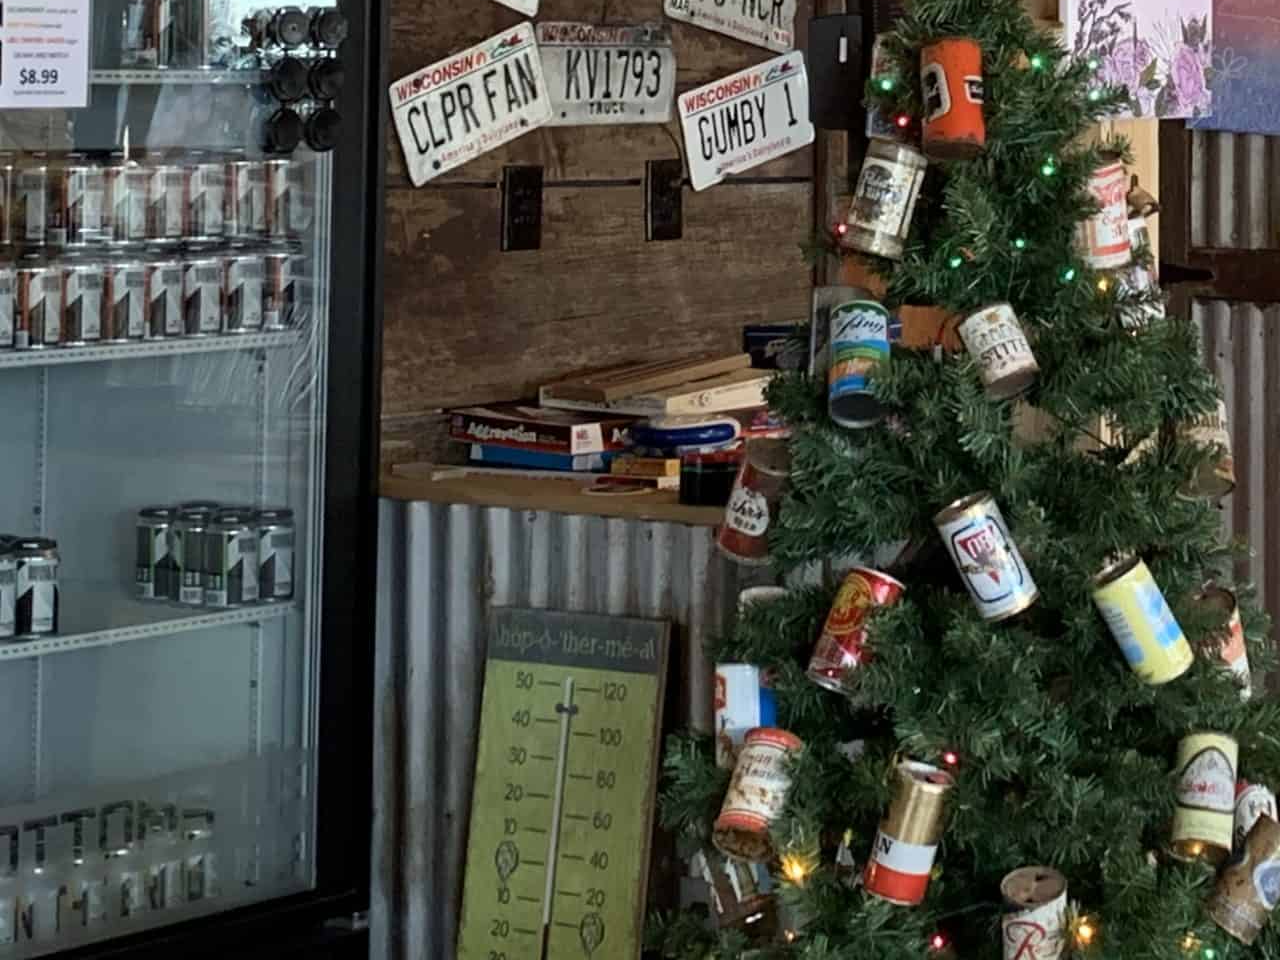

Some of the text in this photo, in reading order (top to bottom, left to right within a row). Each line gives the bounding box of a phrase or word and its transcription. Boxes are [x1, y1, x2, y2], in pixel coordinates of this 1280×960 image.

[19, 67, 59, 85] $8.99
[396, 54, 475, 100] WISCONSIN
[564, 48, 662, 100] KV1793
[684, 73, 754, 112] WISCONSIN
[406, 53, 539, 157] CLPR FAN
[589, 102, 626, 115] TRUCK
[696, 93, 767, 161] GUMBY
[516, 671, 534, 689] 50
[603, 683, 627, 702] 120
[511, 710, 531, 728] 40
[599, 728, 623, 747] 100
[509, 747, 527, 766] 30
[504, 783, 524, 801] 20
[503, 818, 518, 834] 10
[589, 851, 609, 869] 40
[497, 887, 510, 904] 10
[585, 890, 606, 906] 20
[491, 919, 509, 938] 20
